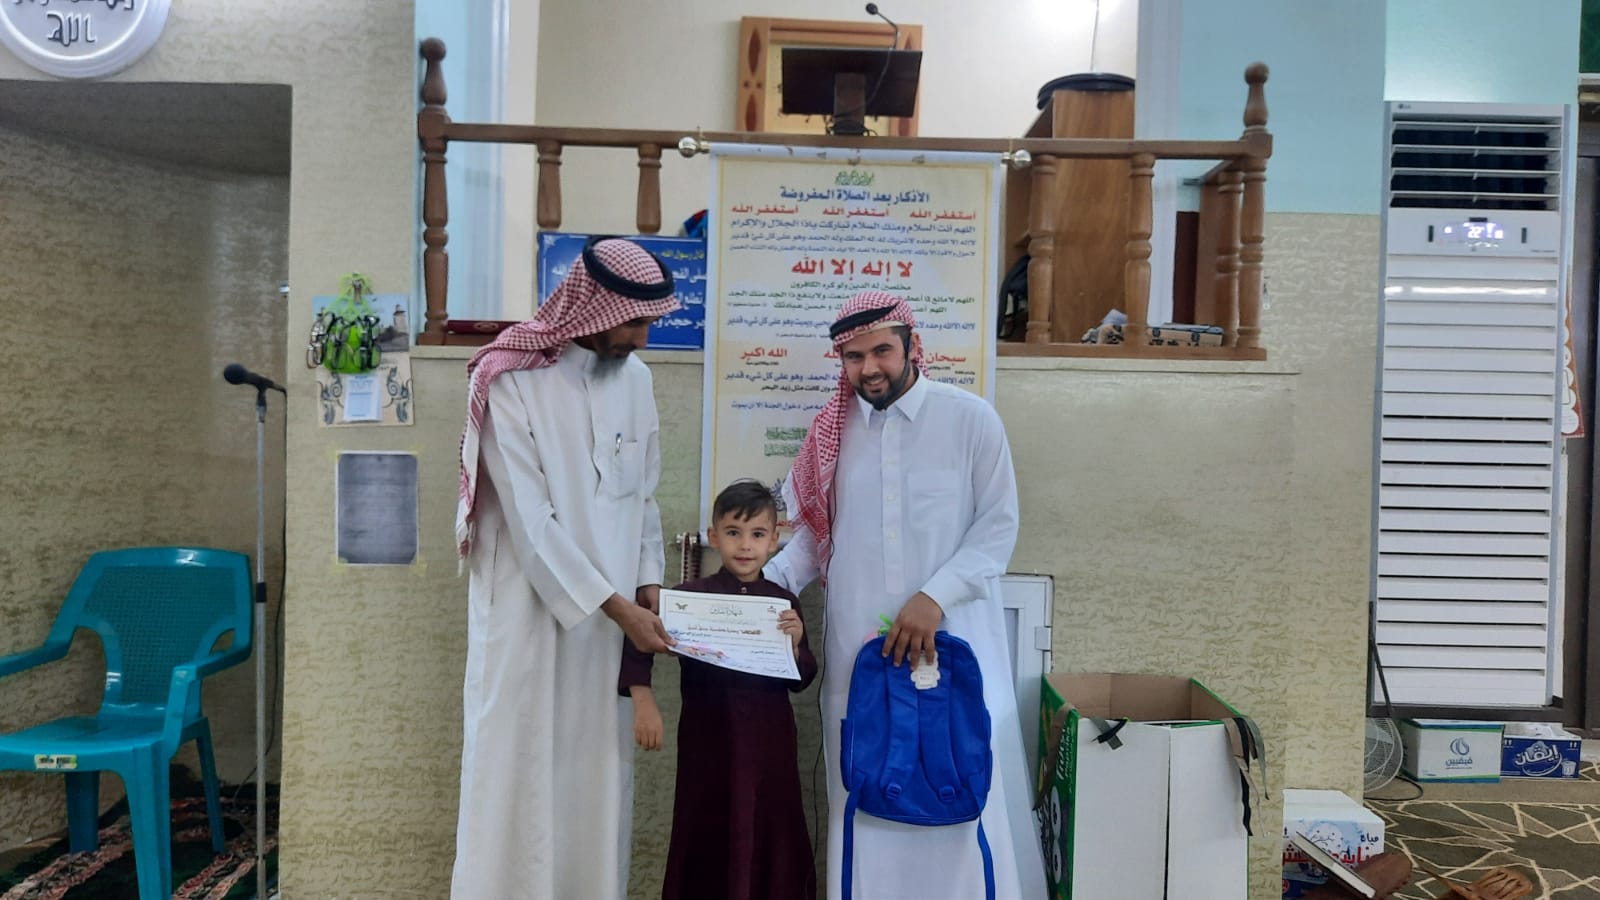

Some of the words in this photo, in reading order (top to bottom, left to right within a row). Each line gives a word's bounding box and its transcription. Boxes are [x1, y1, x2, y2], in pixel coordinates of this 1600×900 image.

[780, 186, 834, 202] المفروضة
[837, 188, 870, 201] الصلاة
[872, 191, 892, 207] بعد
[731, 203, 753, 214] الله
[822, 206, 845, 216] الله
[909, 208, 931, 219] الله
[790, 253, 824, 275] الله
[830, 257, 855, 281] إلا
[860, 259, 891, 282] إله
[896, 260, 913, 278] لا
[767, 347, 788, 358] الله
[925, 351, 968, 367] سبحان
[1360, 832, 1380, 846] مياه
